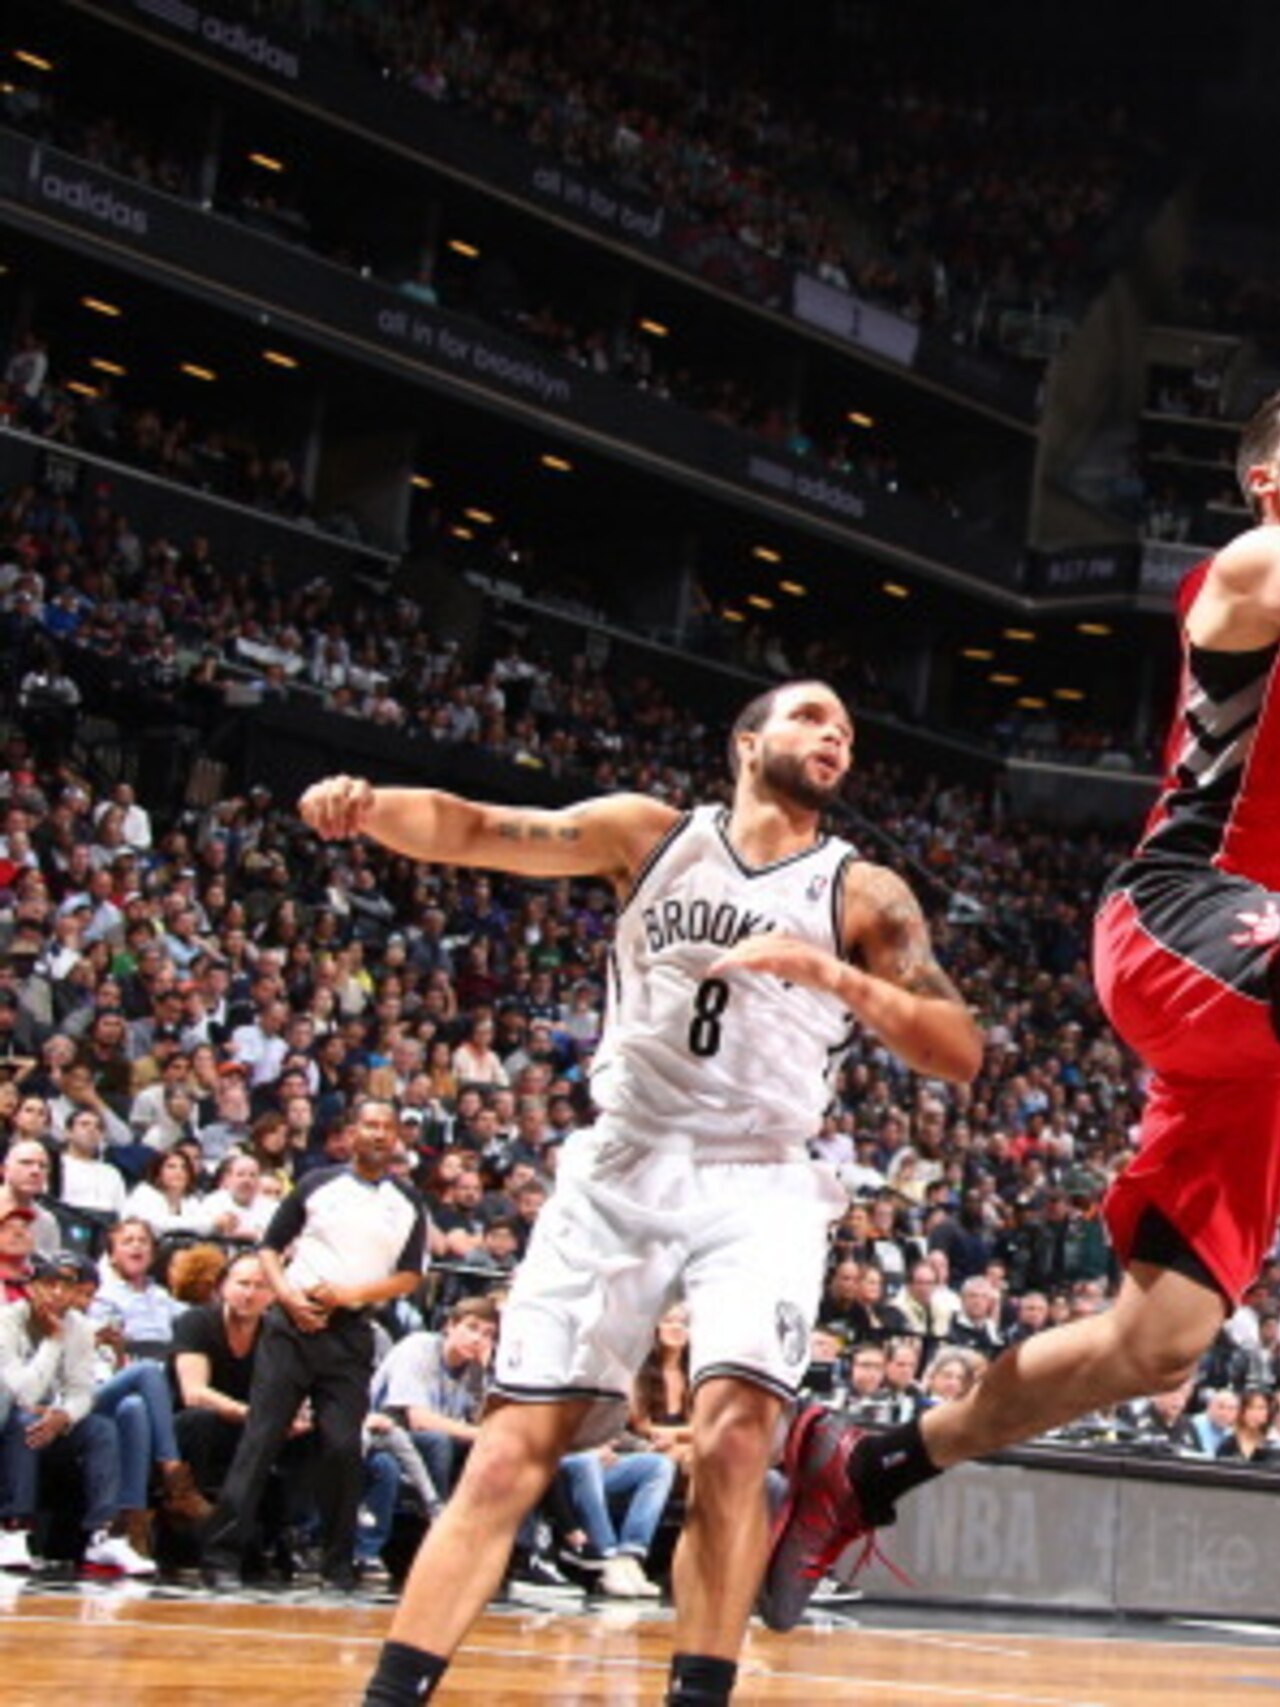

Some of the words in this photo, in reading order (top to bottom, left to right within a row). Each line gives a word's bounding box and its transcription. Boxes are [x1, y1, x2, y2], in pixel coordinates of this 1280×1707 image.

[201, 16, 299, 80] adidas
[42, 174, 149, 235] adidas
[378, 309, 408, 337] all
[412, 321, 433, 346] in
[437, 328, 470, 360] for
[473, 345, 570, 402] brooklyn
[687, 976, 730, 1057] 8
[914, 1482, 1042, 1584] NBA
[1146, 1504, 1259, 1597] Like
